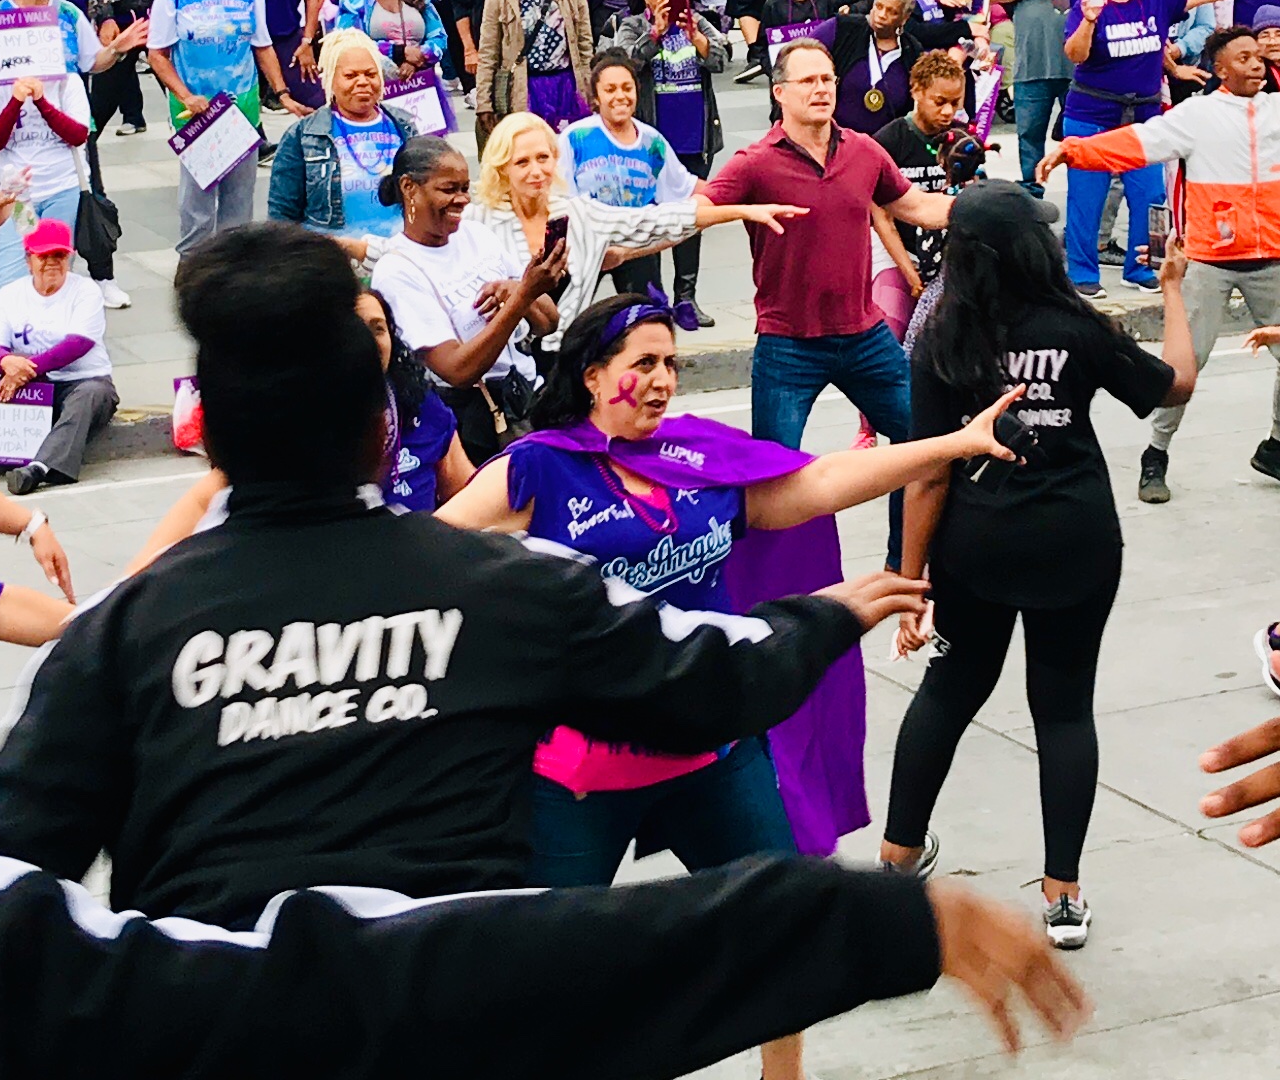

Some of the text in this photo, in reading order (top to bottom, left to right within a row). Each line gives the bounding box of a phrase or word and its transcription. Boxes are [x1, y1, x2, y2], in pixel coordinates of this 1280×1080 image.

[18, 12, 24, 23] I
[4, 33, 22, 48] MY
[787, 28, 809, 38] WHY
[1105, 21, 1148, 41] LAURA'S
[1107, 34, 1162, 58] WARRIORS
[183, 119, 200, 138] WHY
[1008, 349, 1069, 382] VITY
[12, 407, 46, 422] HIJA
[659, 441, 705, 466] LUPUS
[567, 496, 593, 519] Be
[171, 608, 463, 708] GRAVITY
[216, 679, 440, 747] DANCE CO.
